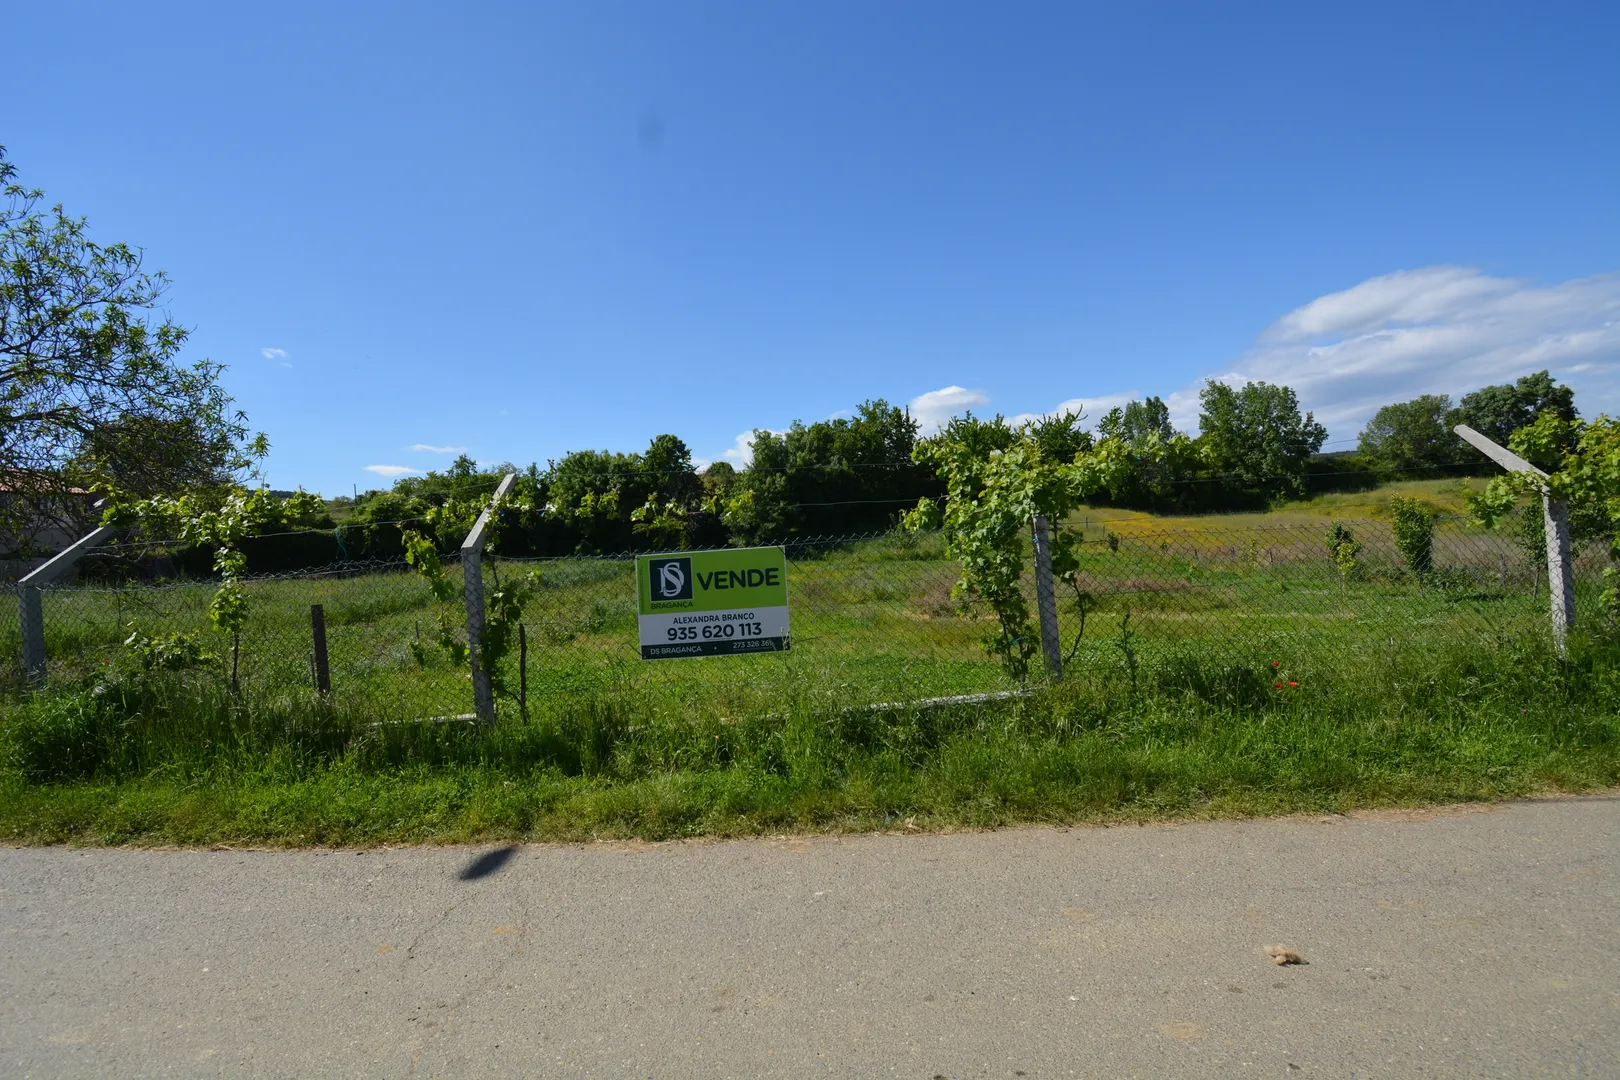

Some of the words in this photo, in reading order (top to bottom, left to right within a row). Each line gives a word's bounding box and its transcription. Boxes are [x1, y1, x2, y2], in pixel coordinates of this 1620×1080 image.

[696, 567, 780, 591] VENDE
[650, 601, 694, 610] BRAGANÇA
[672, 614, 720, 624] ALEXANDRA
[721, 612, 755, 622] BRANCO
[667, 626, 698, 641] 935
[701, 624, 735, 639] 620
[738, 622, 762, 636] 113
[650, 647, 660, 655] DS
[661, 645, 702, 654] BRAGANÇA
[732, 641, 746, 649] 273
[746, 640, 760, 648] 326
